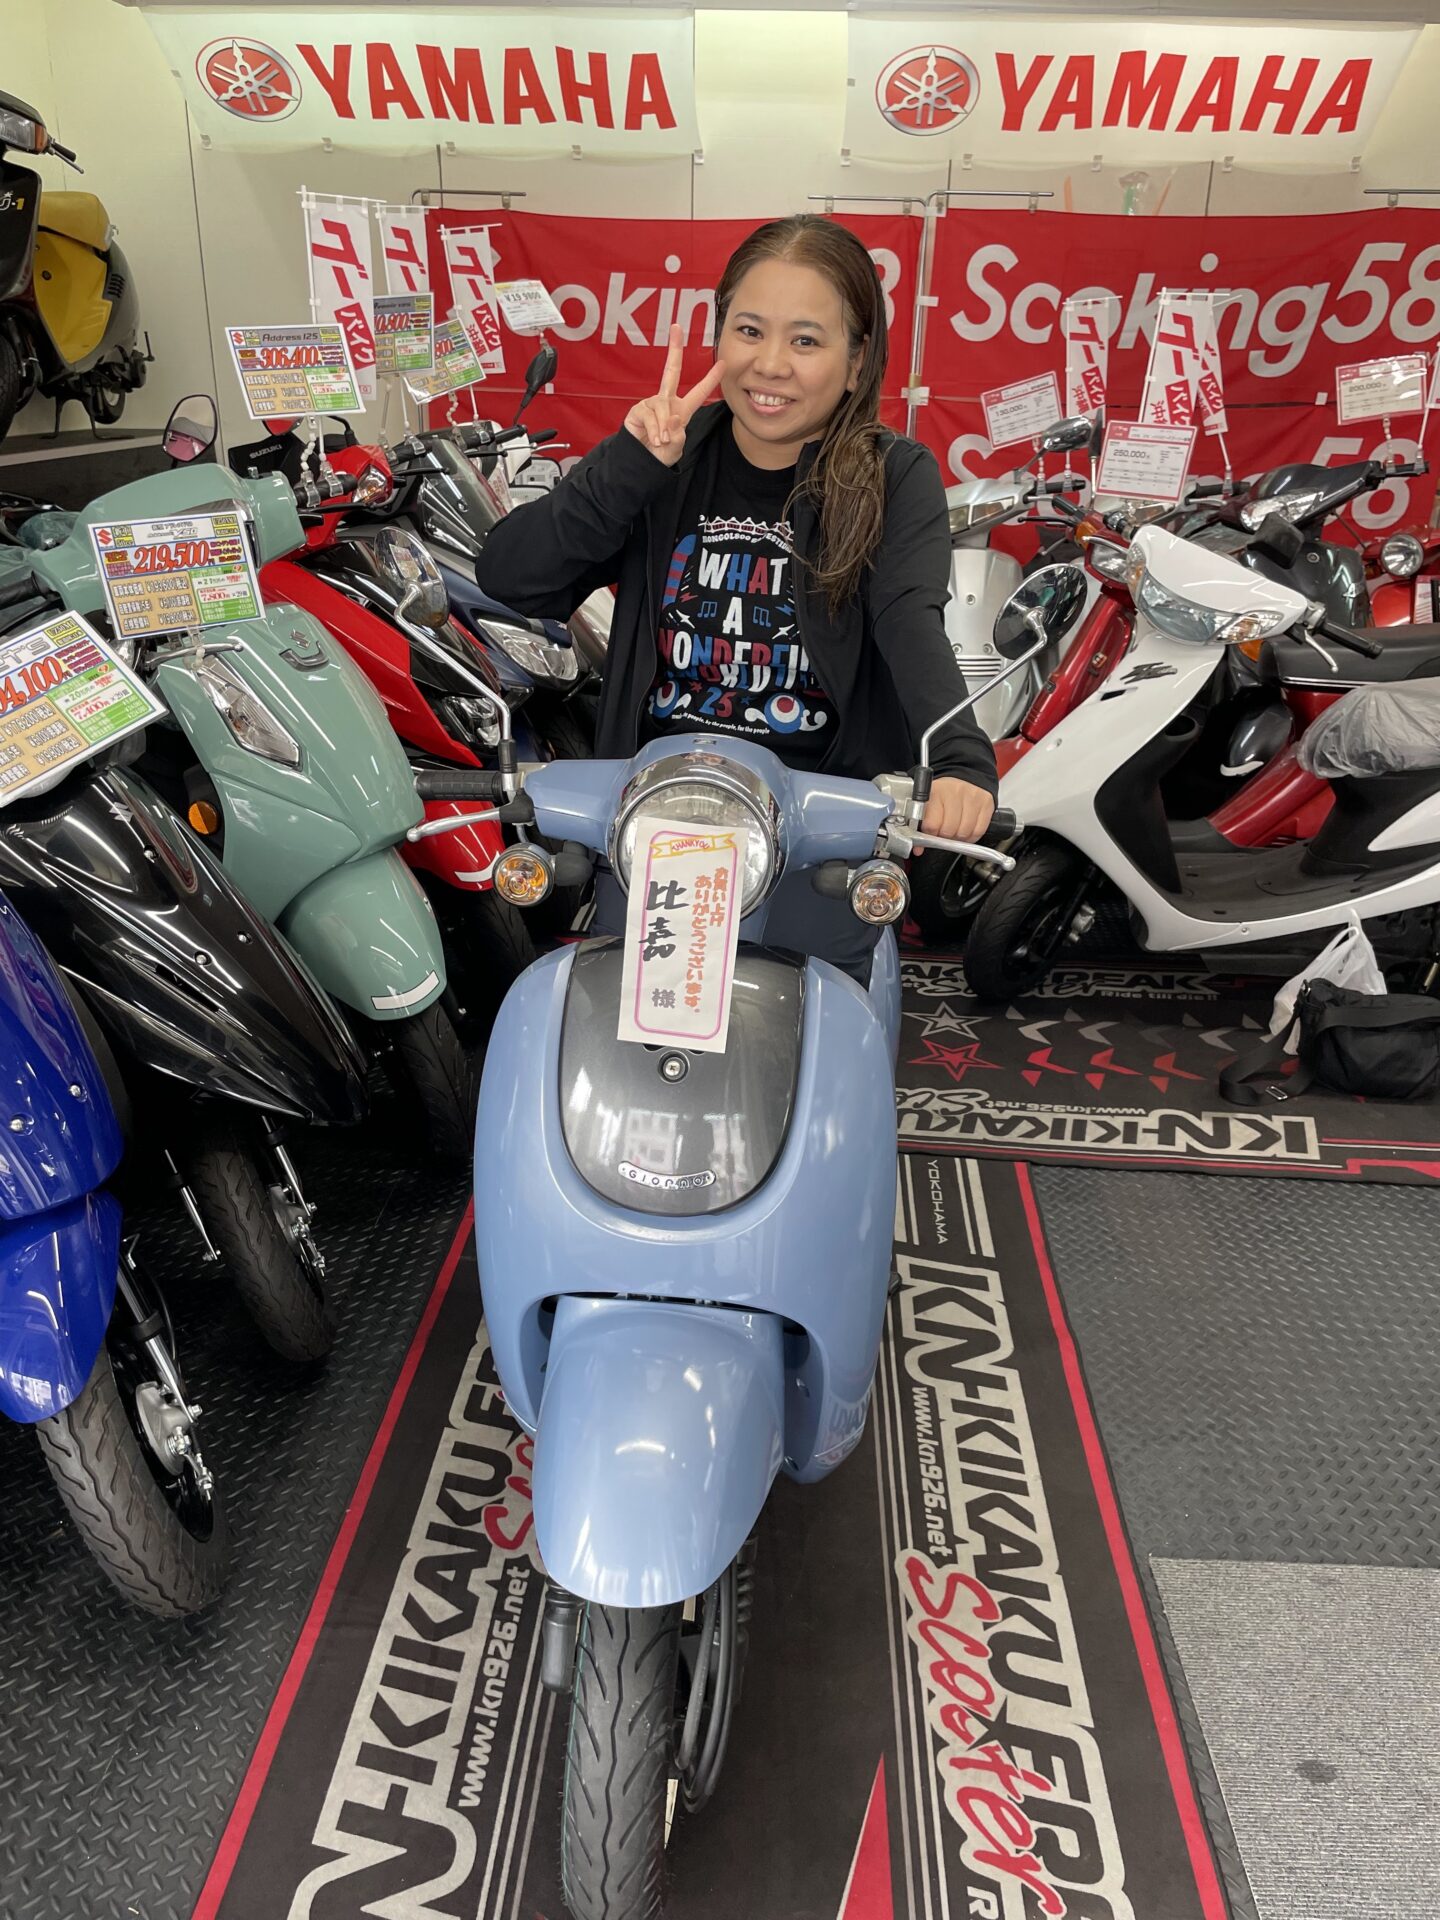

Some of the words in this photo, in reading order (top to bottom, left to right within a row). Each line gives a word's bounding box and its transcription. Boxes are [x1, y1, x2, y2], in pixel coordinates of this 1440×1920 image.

[296, 43, 677, 130] YAMAHA
[995, 51, 1372, 135] YAMAHA
[262, 333, 301, 342] Address
[303, 332, 318, 340] 125
[249, 444, 282, 459] SUZUKI
[698, 548, 789, 596] WHAT
[722, 596, 743, 636] A
[985, 1100, 1147, 1117] www.kn926.net
[927, 1159, 949, 1246] YOKOHAMA
[911, 1386, 953, 1558] www.kn926.net
[458, 1565, 531, 1807] www.kn926.net
